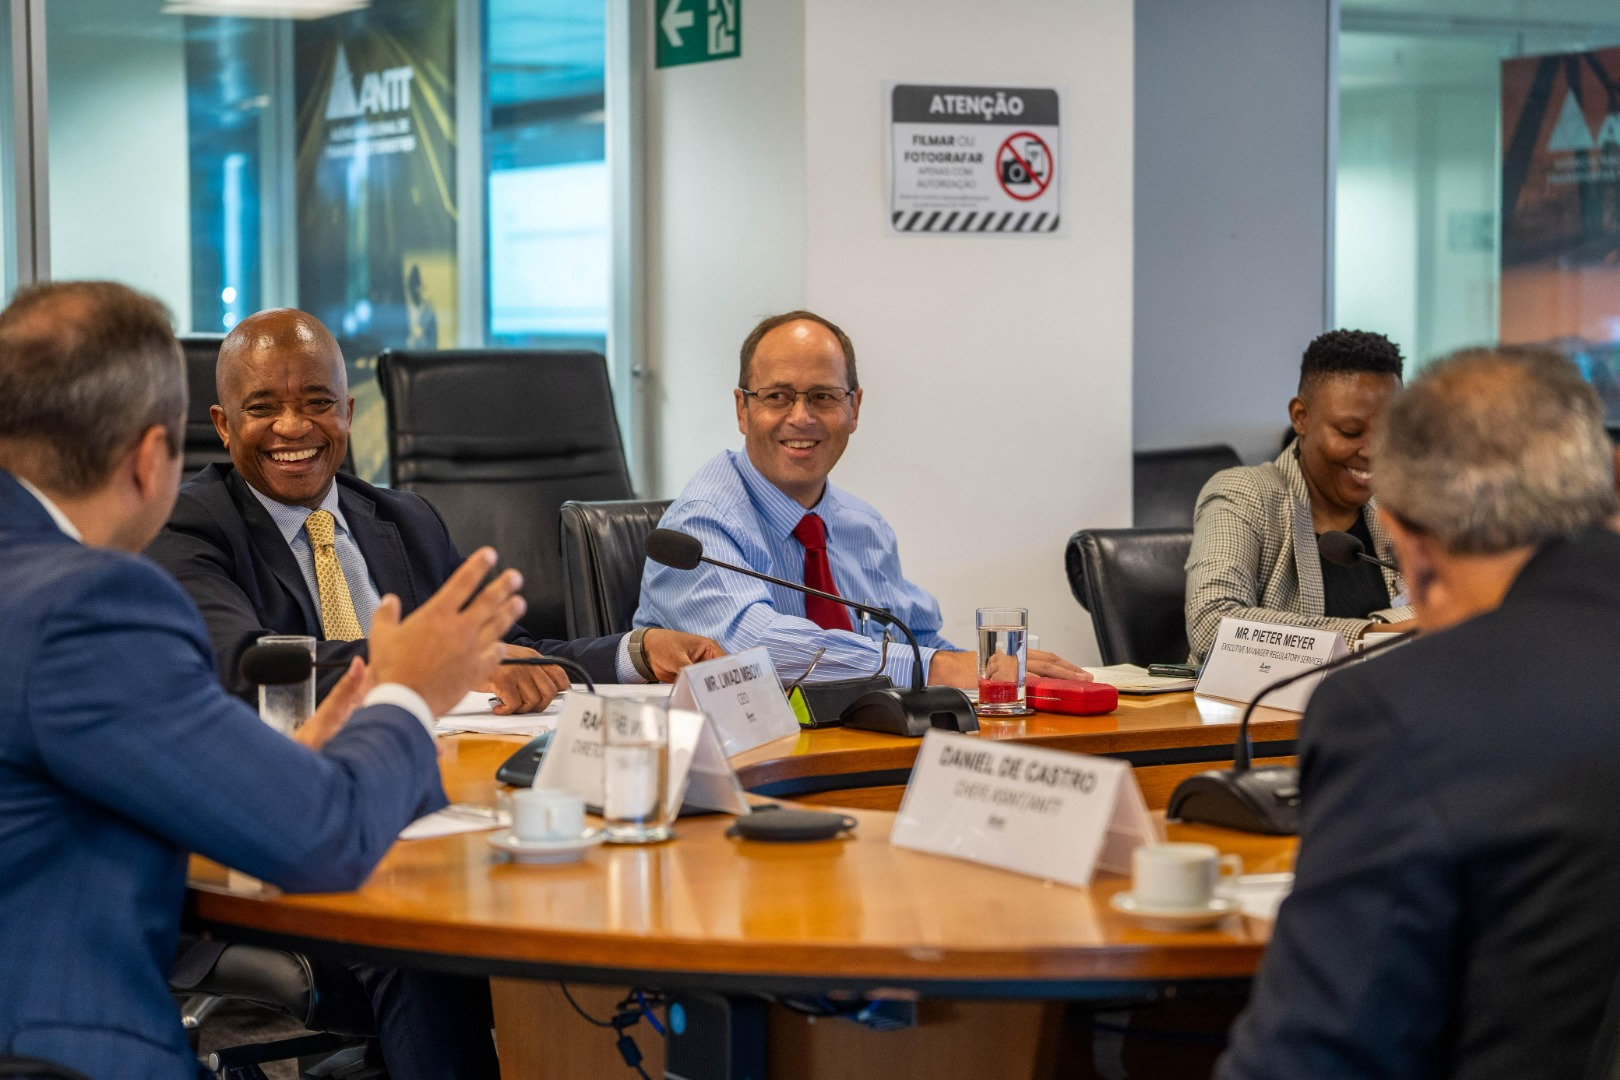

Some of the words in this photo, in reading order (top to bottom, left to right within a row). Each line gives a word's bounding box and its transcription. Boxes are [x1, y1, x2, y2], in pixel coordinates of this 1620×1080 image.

[929, 92, 1024, 121] ATENÇÃO
[912, 134, 954, 147] FILMAR
[957, 135, 975, 147] OU
[904, 151, 983, 163] FOTOGRAFAR
[1234, 626, 1249, 641] MR.
[1251, 628, 1283, 646] PIETER
[1283, 633, 1316, 651] MEYER
[1221, 642, 1246, 654] EXECUTIVE
[1245, 646, 1270, 658] MANAGER
[1269, 650, 1301, 663] REGULATORY
[1300, 655, 1324, 666] SERVICES
[704, 675, 720, 692] MR.
[718, 667, 742, 689] LWAZI
[938, 745, 995, 776] DANIEL
[998, 755, 1023, 781] DE
[1024, 760, 1099, 795] CASTRO
